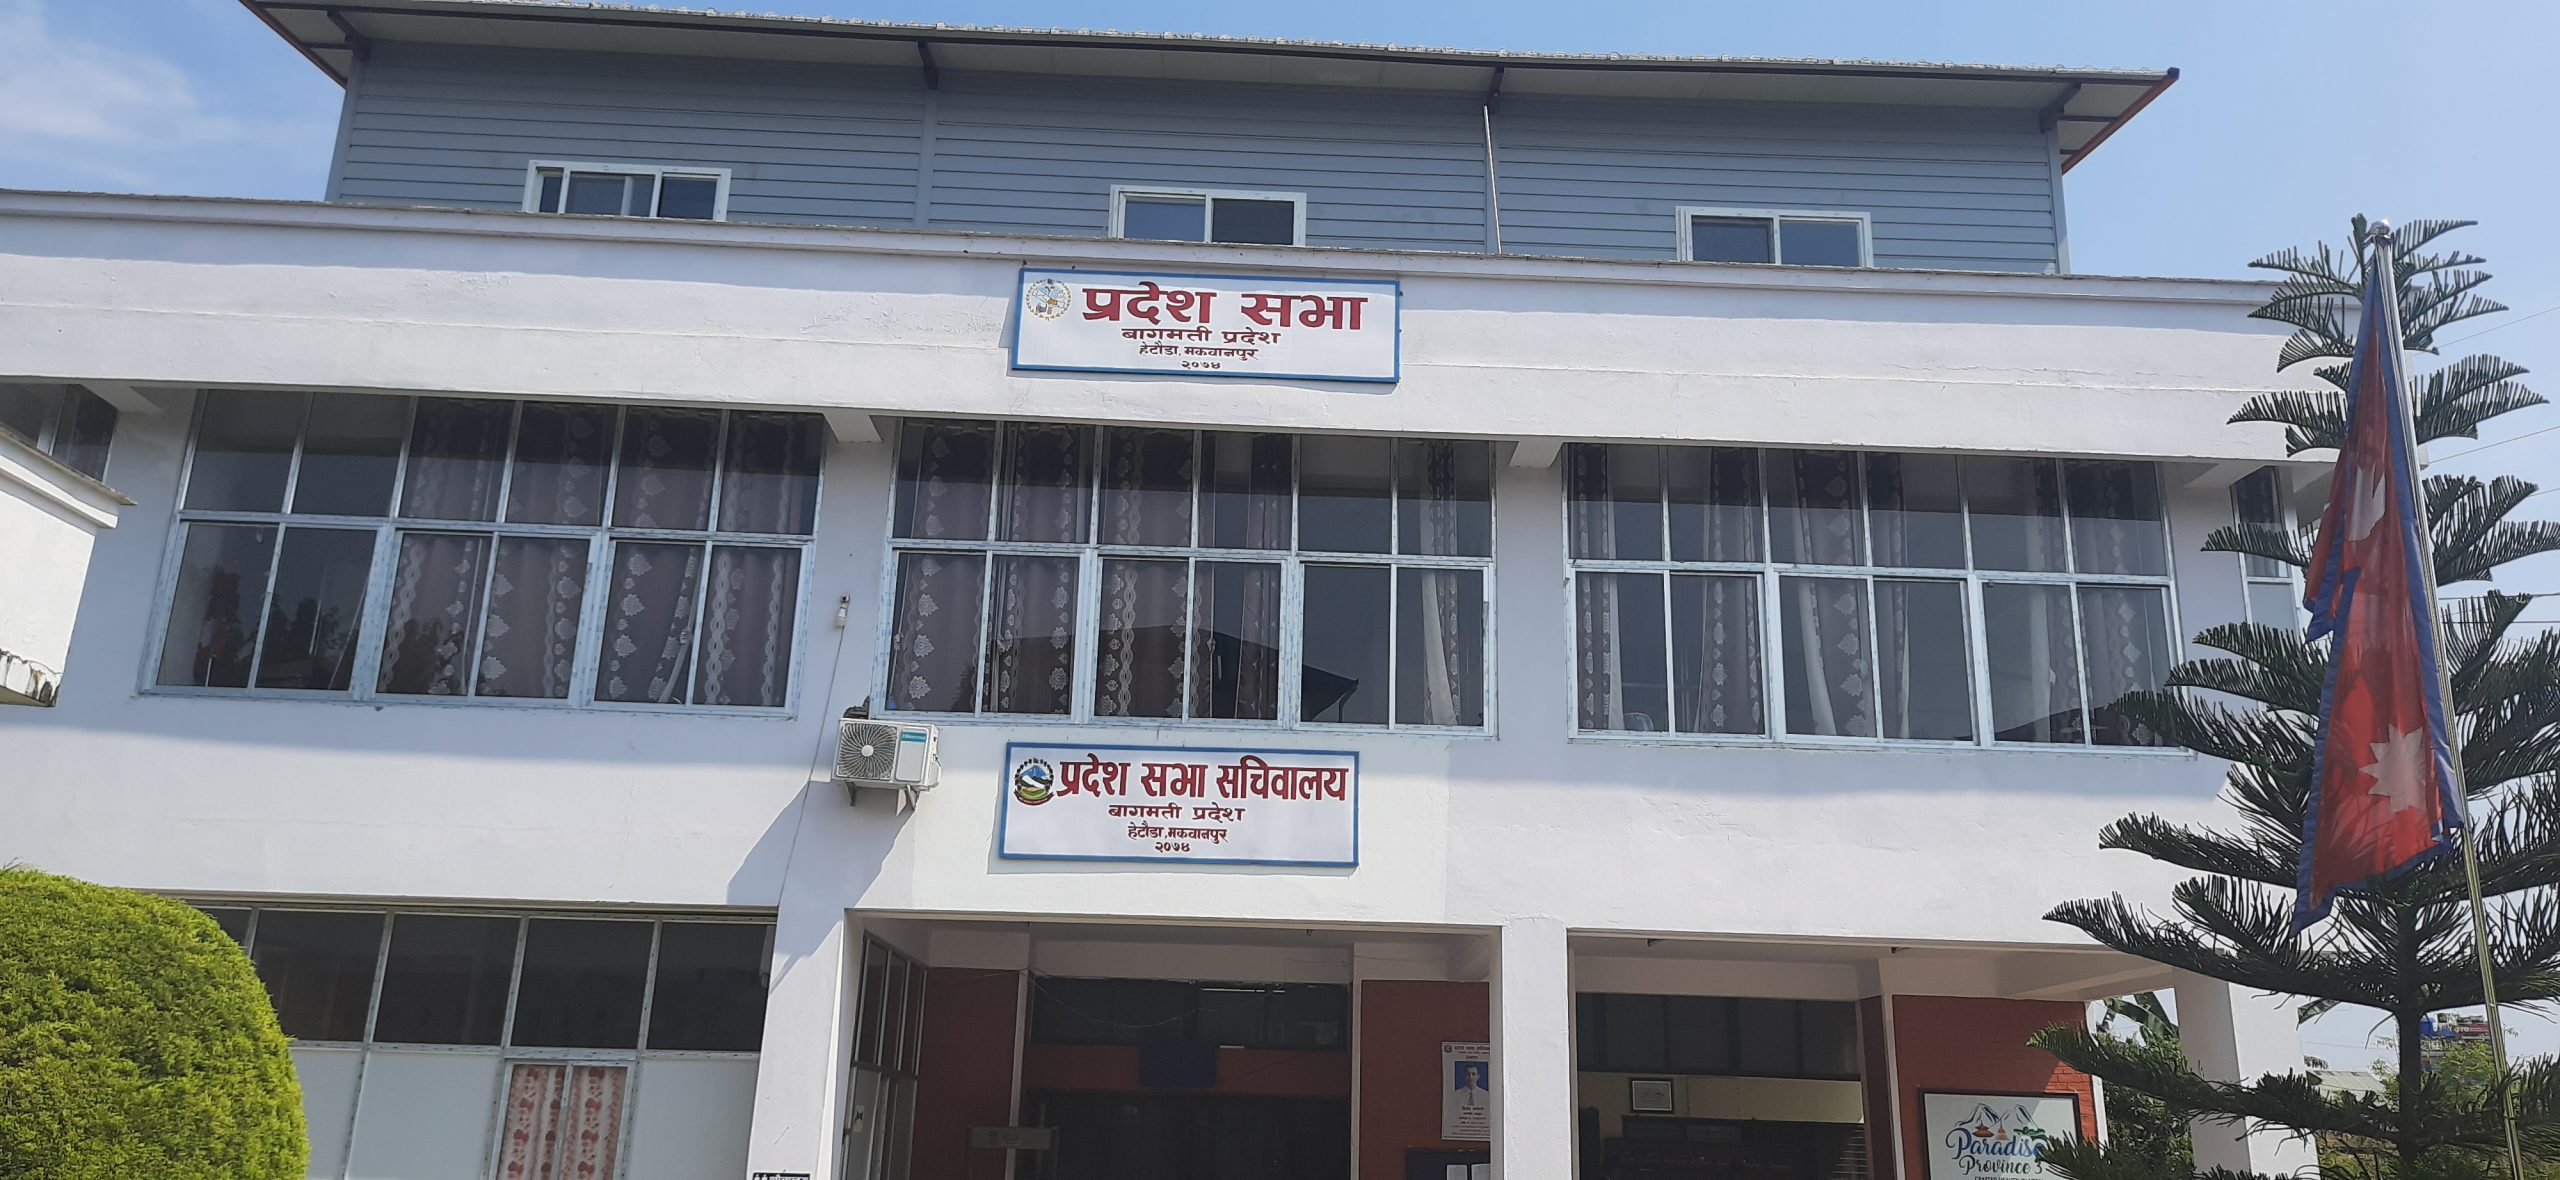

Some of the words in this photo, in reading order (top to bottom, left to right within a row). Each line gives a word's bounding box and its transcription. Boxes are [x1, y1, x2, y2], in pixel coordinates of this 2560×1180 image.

[1082, 281, 1217, 325] प्रदेश
[1240, 293, 1369, 330] सभा
[1121, 326, 1212, 341] बागमती
[1222, 327, 1281, 345] प्रदेश
[1184, 346, 1259, 361] मकवानपुर
[1181, 360, 1221, 370] २०७४
[1056, 752, 1131, 797] प्रदेश
[1141, 763, 1208, 797] सभा
[1216, 755, 1349, 800] सचिवालय
[1108, 802, 1182, 819] बागमती
[1192, 802, 1245, 823] प्रदेश
[1155, 842, 1190, 853] २०७४
[1958, 1155, 2031, 1175] Province
[2034, 1160, 2043, 1174] 3
